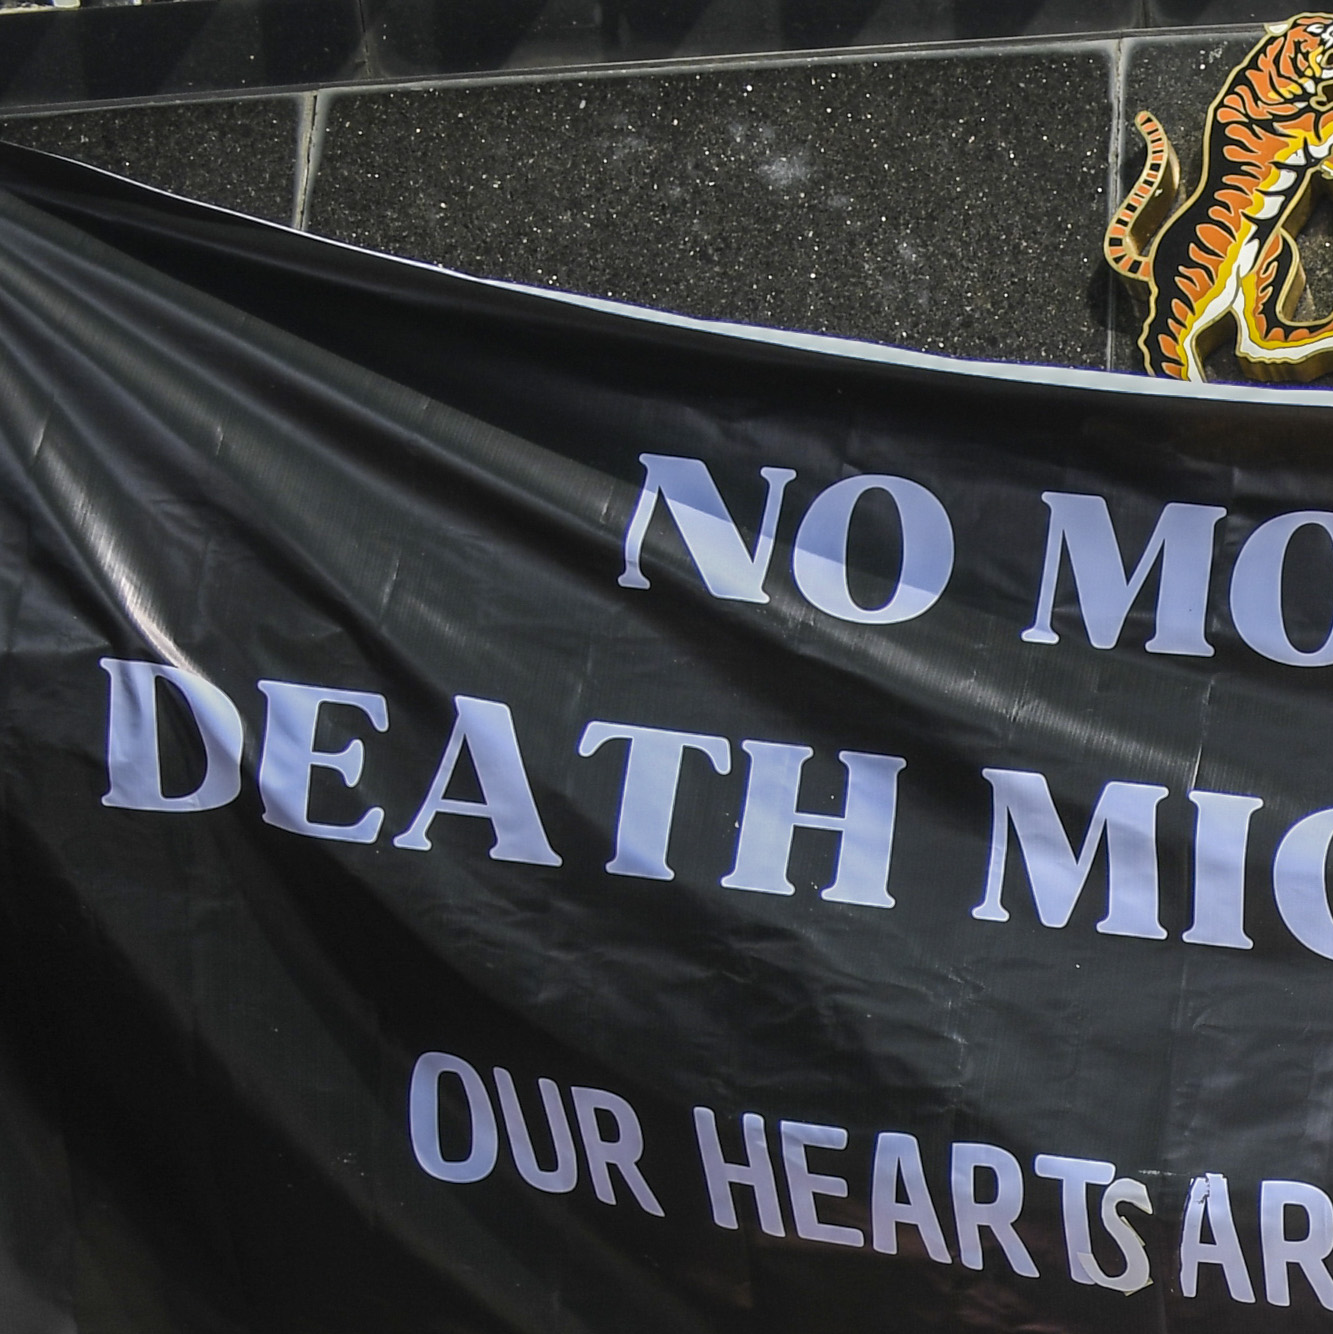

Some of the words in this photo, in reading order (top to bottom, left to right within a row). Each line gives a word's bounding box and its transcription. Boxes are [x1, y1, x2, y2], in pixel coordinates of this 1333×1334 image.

[617, 453, 955, 625] NO
[99, 655, 907, 909] DEATH
[410, 1054, 665, 1217] OUR
[693, 1106, 1154, 1293] HEARTS
